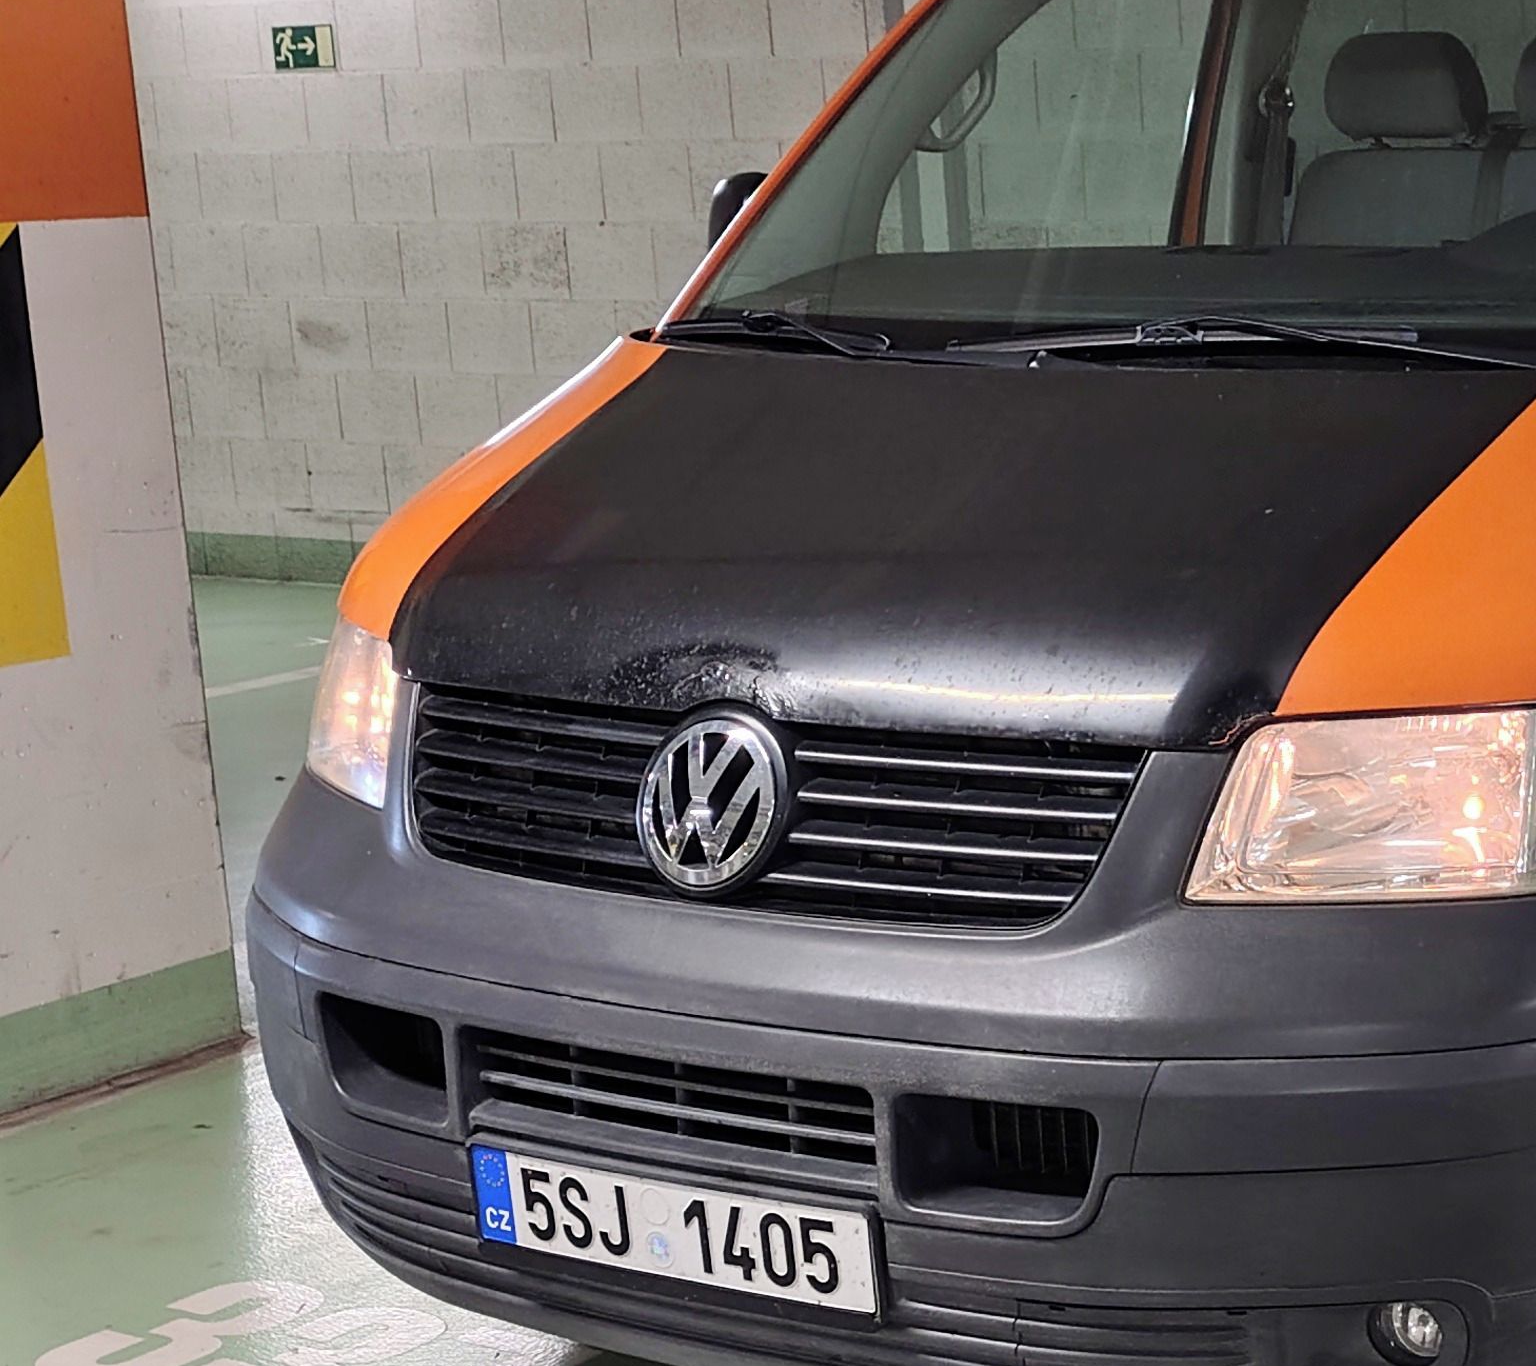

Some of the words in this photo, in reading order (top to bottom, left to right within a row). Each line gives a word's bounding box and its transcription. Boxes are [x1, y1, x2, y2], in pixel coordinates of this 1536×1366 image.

[485, 1206, 512, 1232] CZ
[520, 1167, 631, 1257] 5SJ
[683, 1199, 839, 1294] 1405
